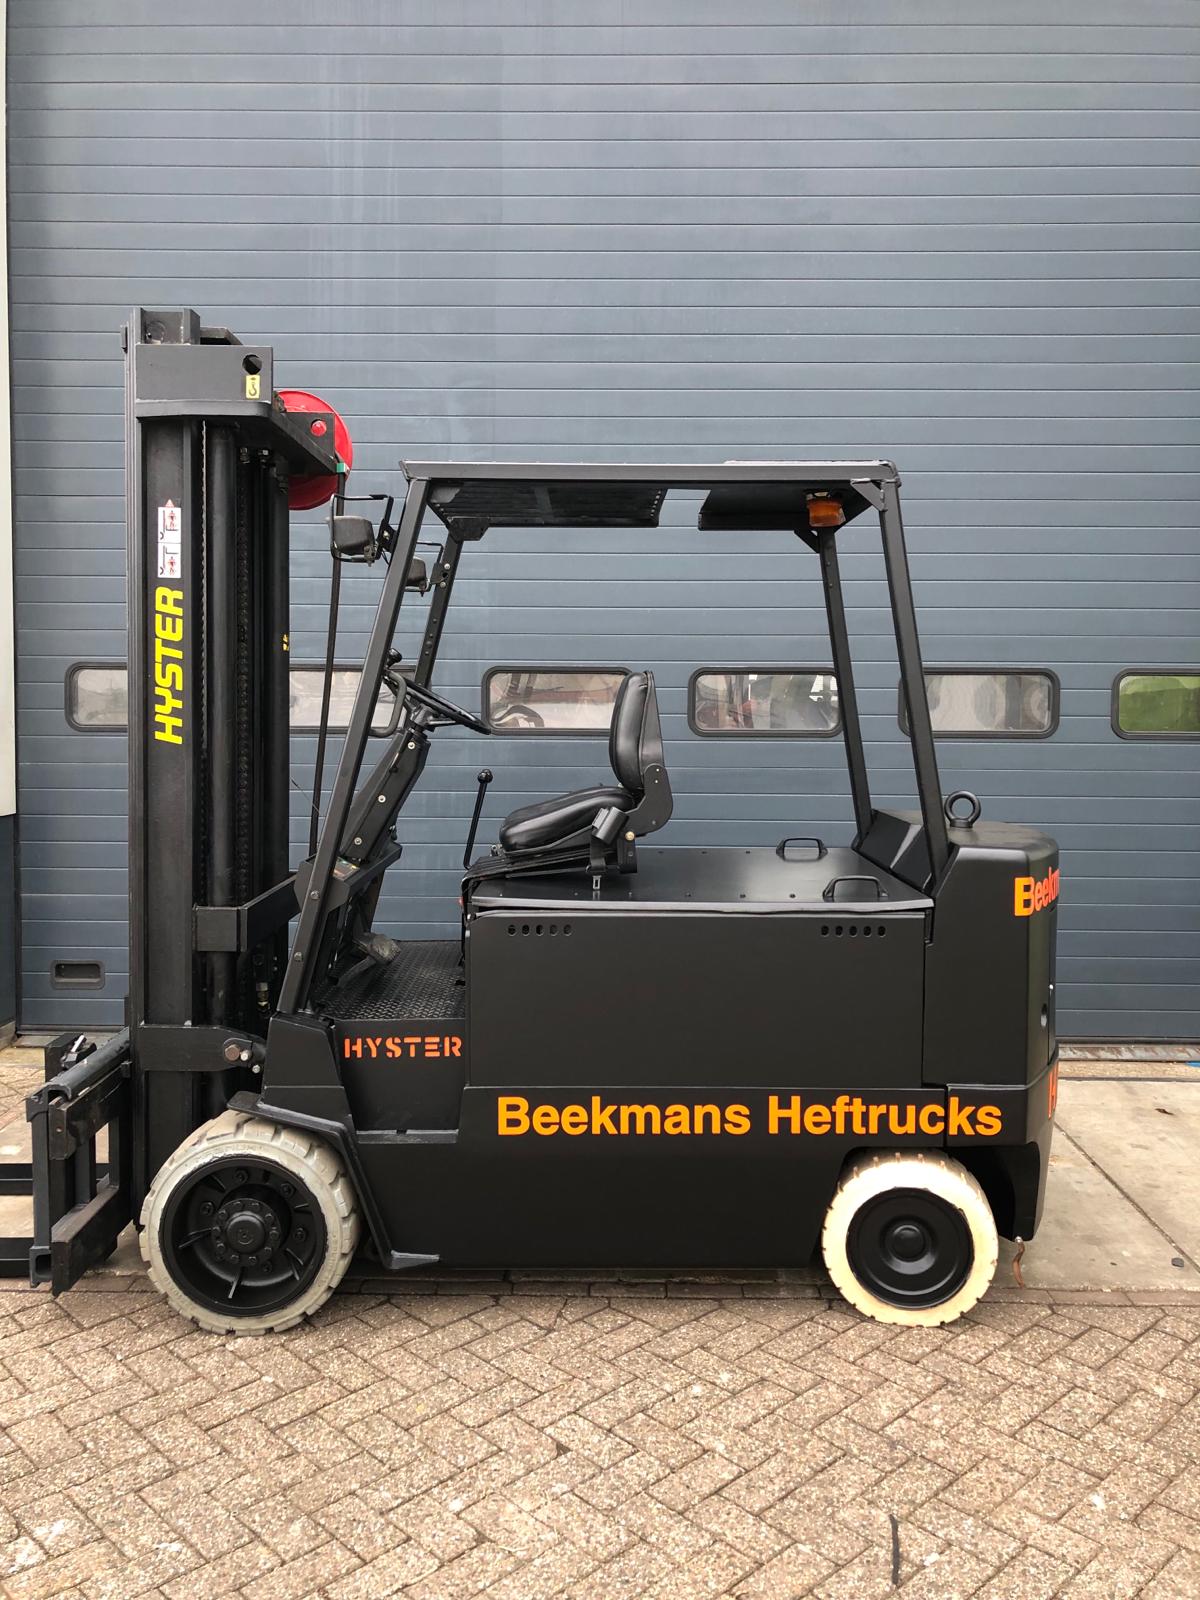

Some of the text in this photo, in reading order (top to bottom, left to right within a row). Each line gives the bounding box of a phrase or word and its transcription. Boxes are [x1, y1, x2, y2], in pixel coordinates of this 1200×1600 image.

[154, 586, 184, 744] HYSTER
[344, 1036, 462, 1058] HYSTER
[497, 1095, 1002, 1136] Beekmans Heftrucks
